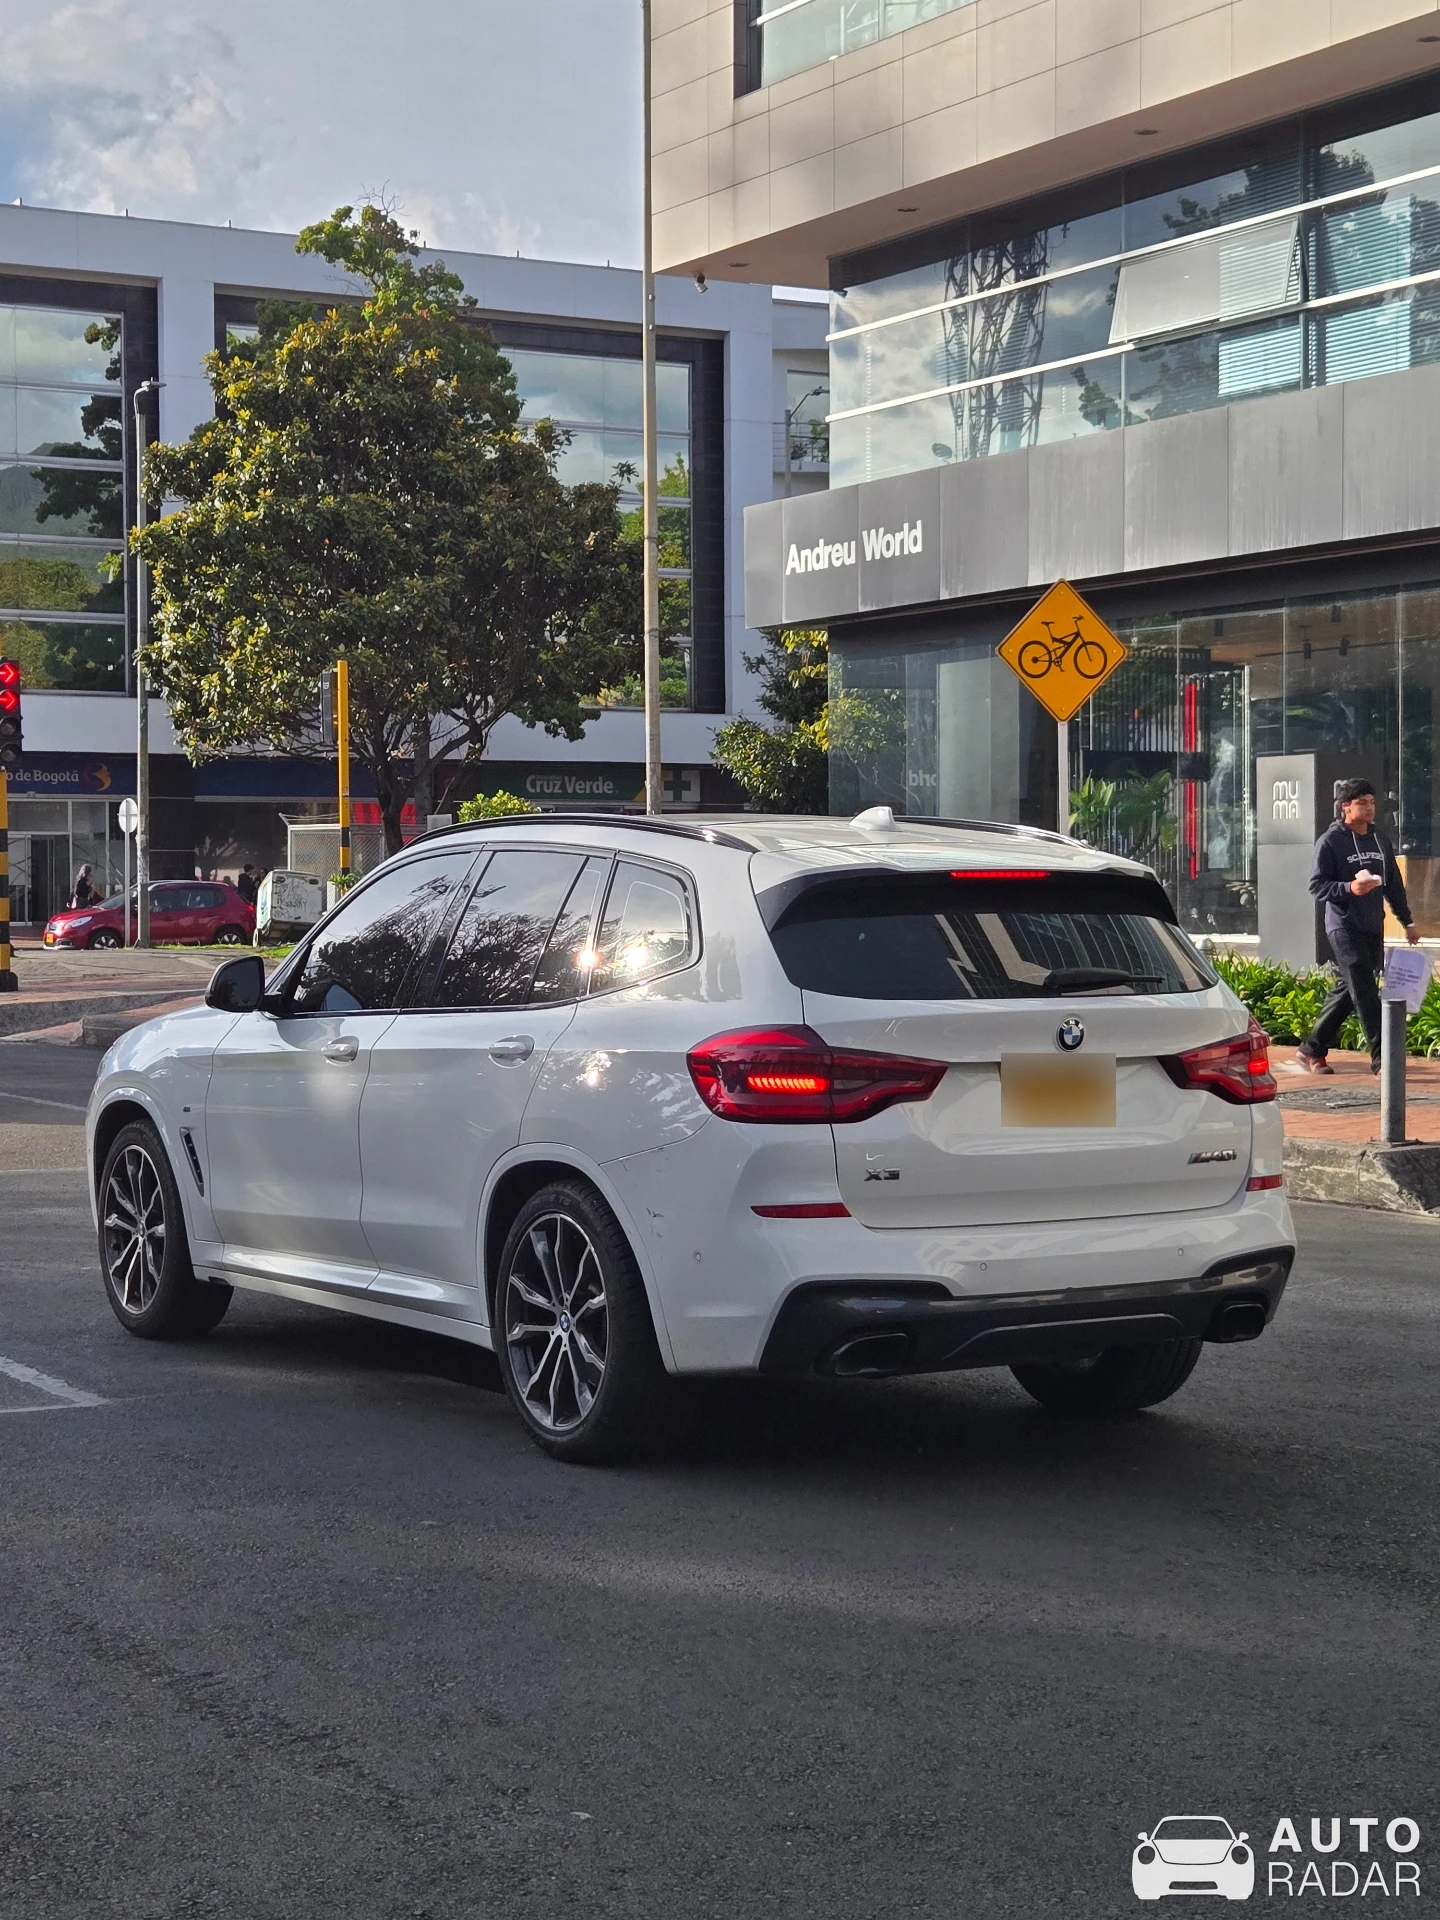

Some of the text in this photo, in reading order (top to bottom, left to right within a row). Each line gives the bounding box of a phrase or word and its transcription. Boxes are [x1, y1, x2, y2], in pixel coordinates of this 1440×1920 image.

[785, 519, 923, 575] Andreu World
[15, 769, 31, 781] de
[33, 769, 79, 785] Bogotá
[526, 775, 614, 794] Cruz Verde
[863, 1168, 900, 1181] X3
